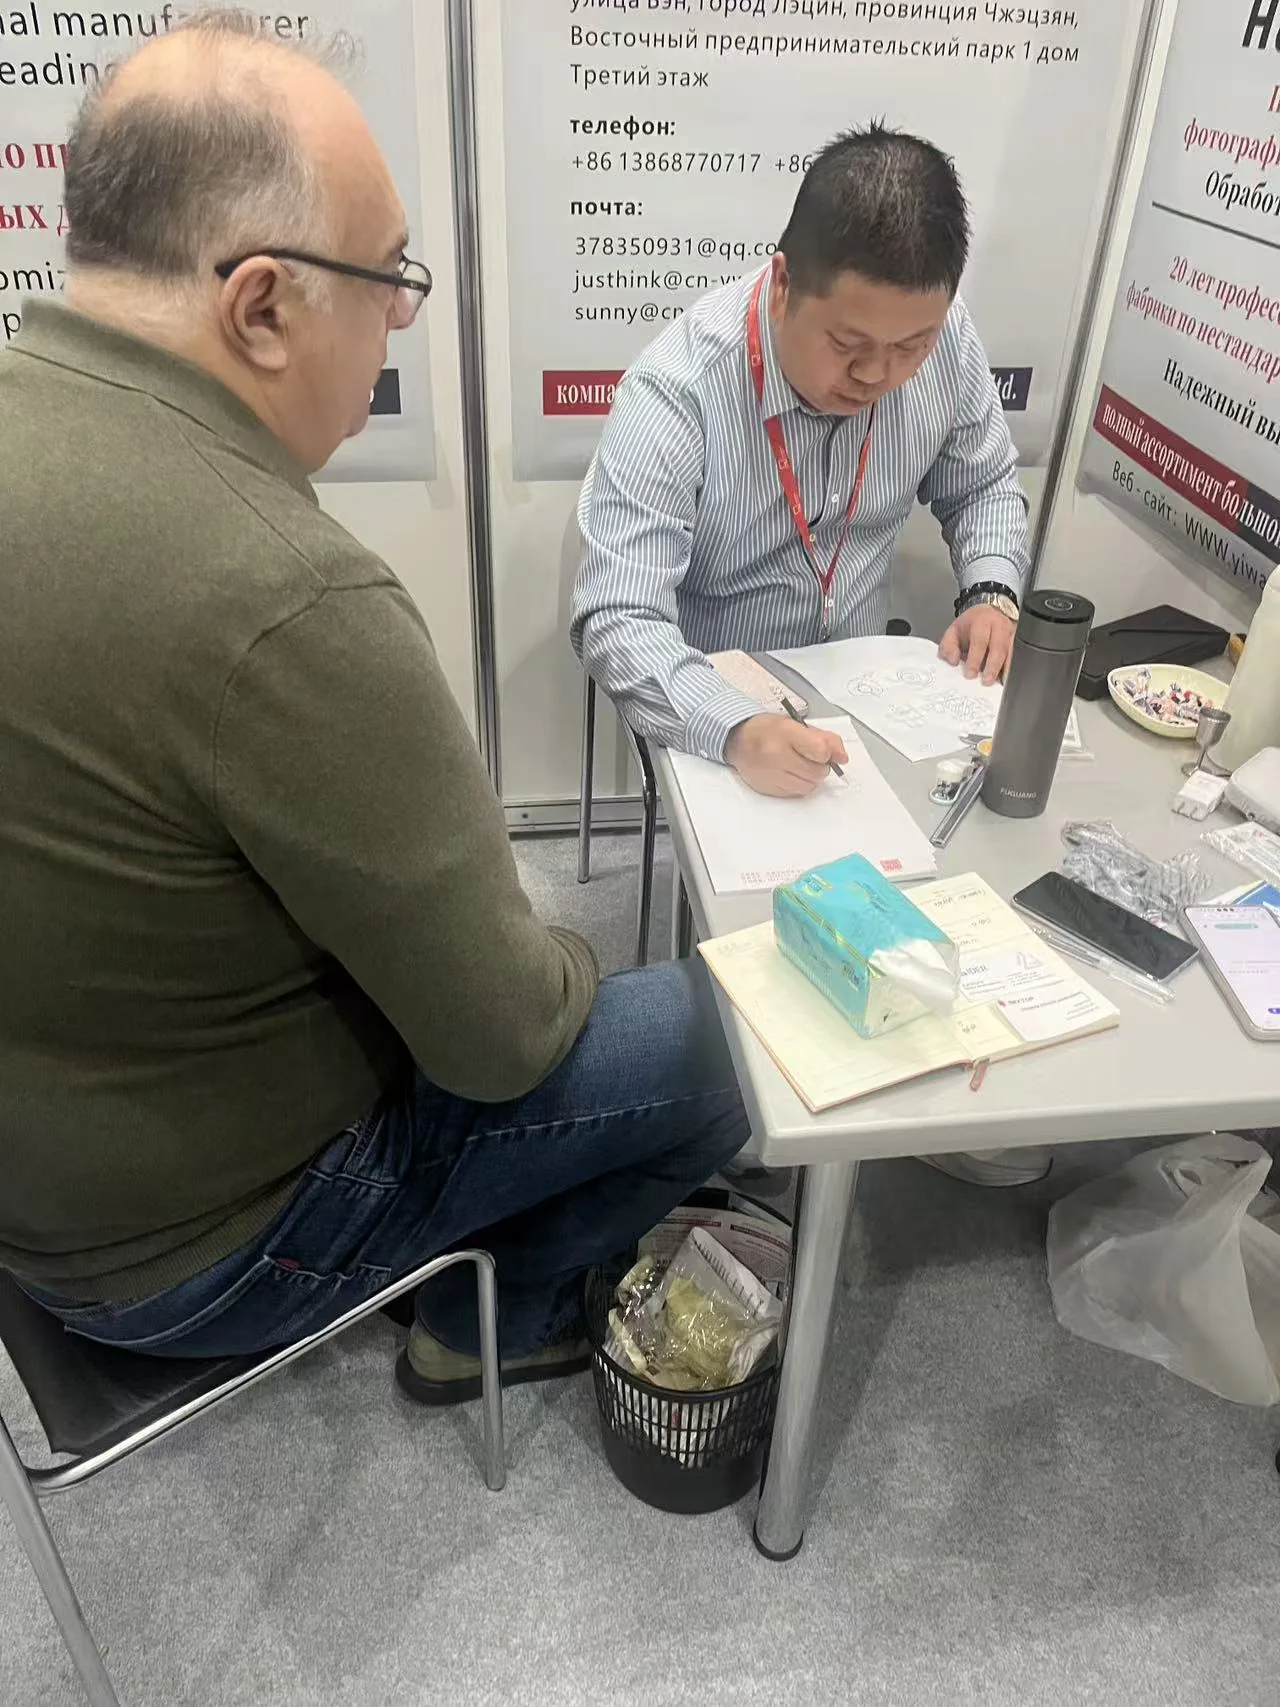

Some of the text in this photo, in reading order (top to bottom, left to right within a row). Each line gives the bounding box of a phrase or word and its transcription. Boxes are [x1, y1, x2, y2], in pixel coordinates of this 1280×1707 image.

[0, 1, 40, 36] al
[699, 0, 766, 18] город
[855, 1, 977, 25] провинция
[985, 2, 1079, 29] Чжэцзян,
[571, 25, 1079, 64] Восточный предпринимательский парк 1 дом
[570, 64, 710, 90] Третий этаж
[570, 115, 676, 140] телефон:
[1184, 118, 1280, 171] фотограф
[572, 151, 612, 171] +86
[620, 151, 761, 173] 13868770717
[571, 201, 643, 216] почта:
[1126, 280, 1177, 327] фабрики
[1177, 312, 1197, 336] по
[1169, 255, 1280, 326] 20 лет профес
[1164, 357, 1257, 429] Надежный
[1102, 403, 1145, 449] полный
[1140, 431, 1223, 505] ассортимент
[1112, 460, 1134, 492] Веб
[1144, 490, 1177, 528] сайт:
